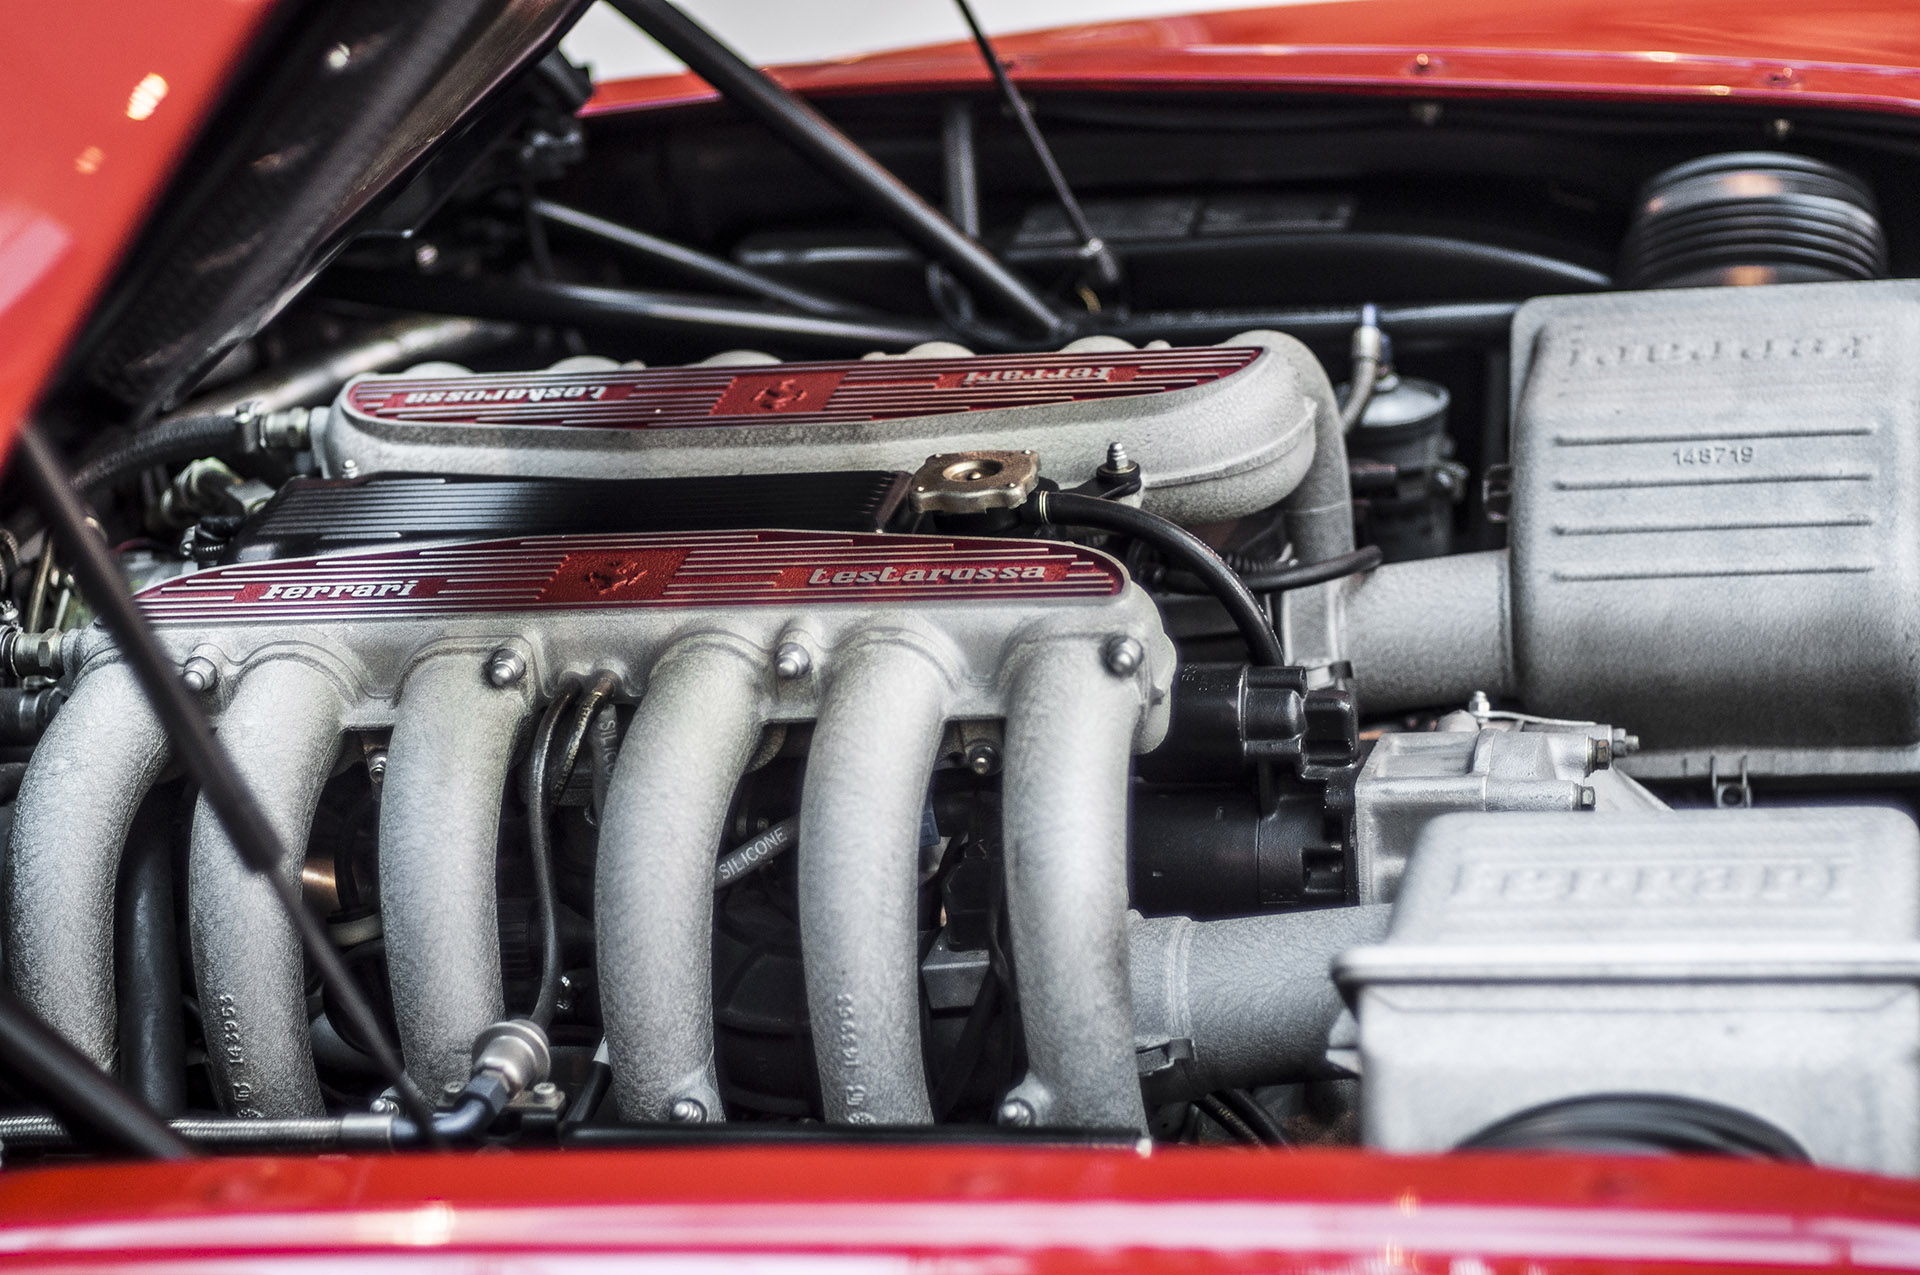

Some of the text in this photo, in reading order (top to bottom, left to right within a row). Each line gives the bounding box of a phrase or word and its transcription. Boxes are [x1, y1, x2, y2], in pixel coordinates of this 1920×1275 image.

[962, 367, 1116, 386] Ferrari
[404, 386, 607, 404] testarossa
[808, 566, 1046, 585] testarossa
[258, 580, 419, 600] Ferrari
[600, 720, 618, 782] SILICO
[718, 826, 788, 880] SILICONE
